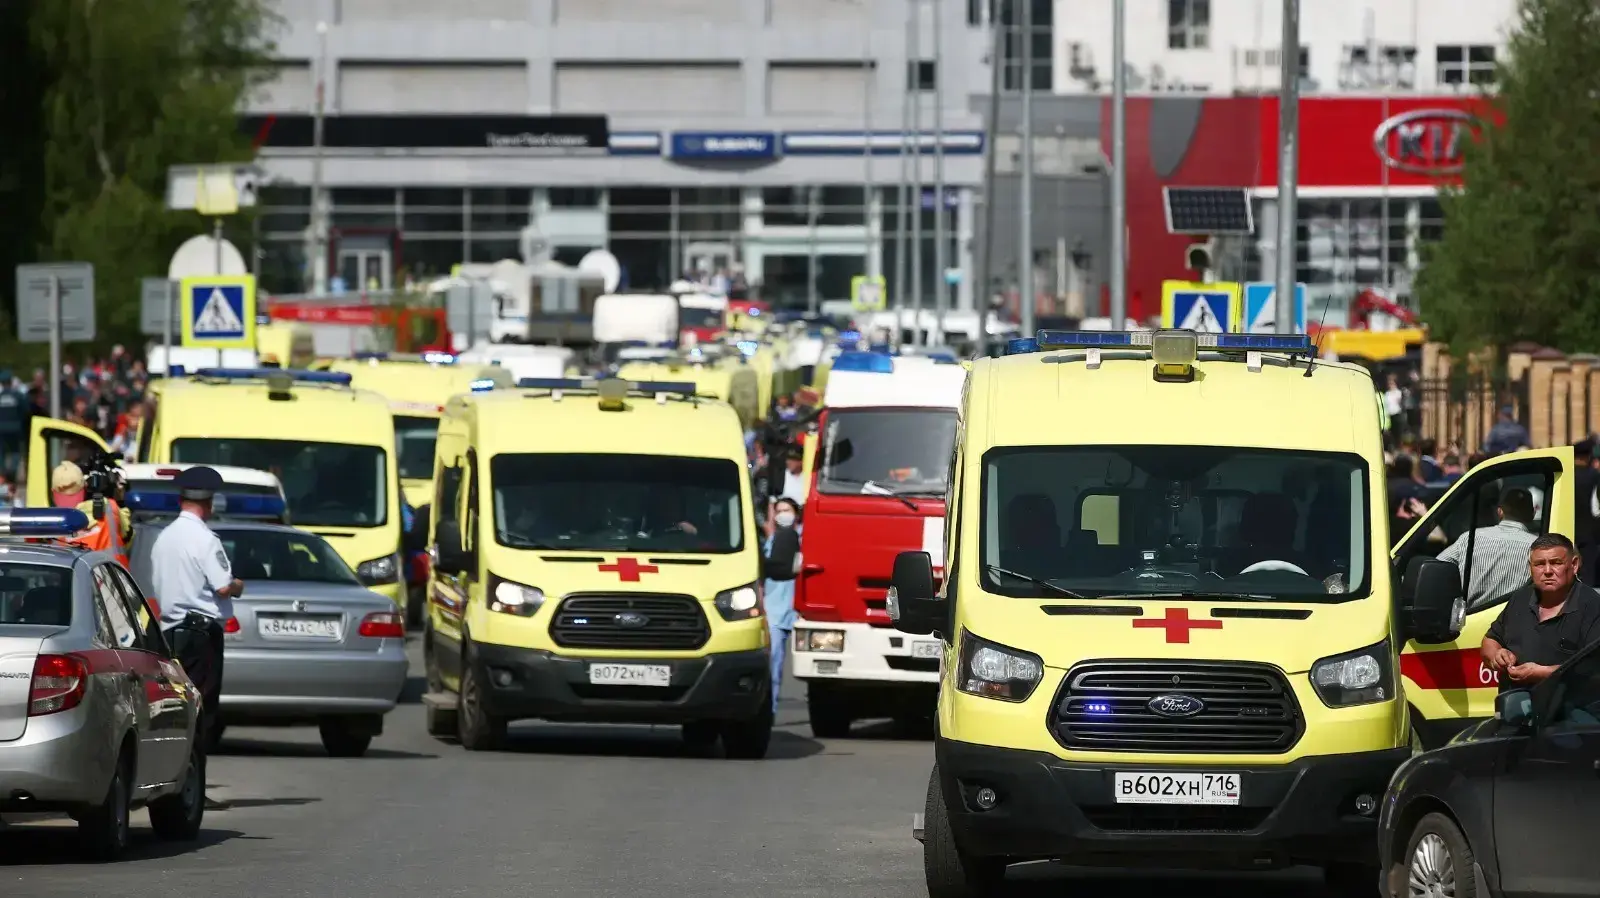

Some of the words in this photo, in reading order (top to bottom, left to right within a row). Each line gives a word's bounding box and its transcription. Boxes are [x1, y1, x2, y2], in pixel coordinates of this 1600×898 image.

[0, 671, 30, 679] RANTA
[1161, 698, 1191, 711] Ford
[1204, 775, 1233, 790] 716
